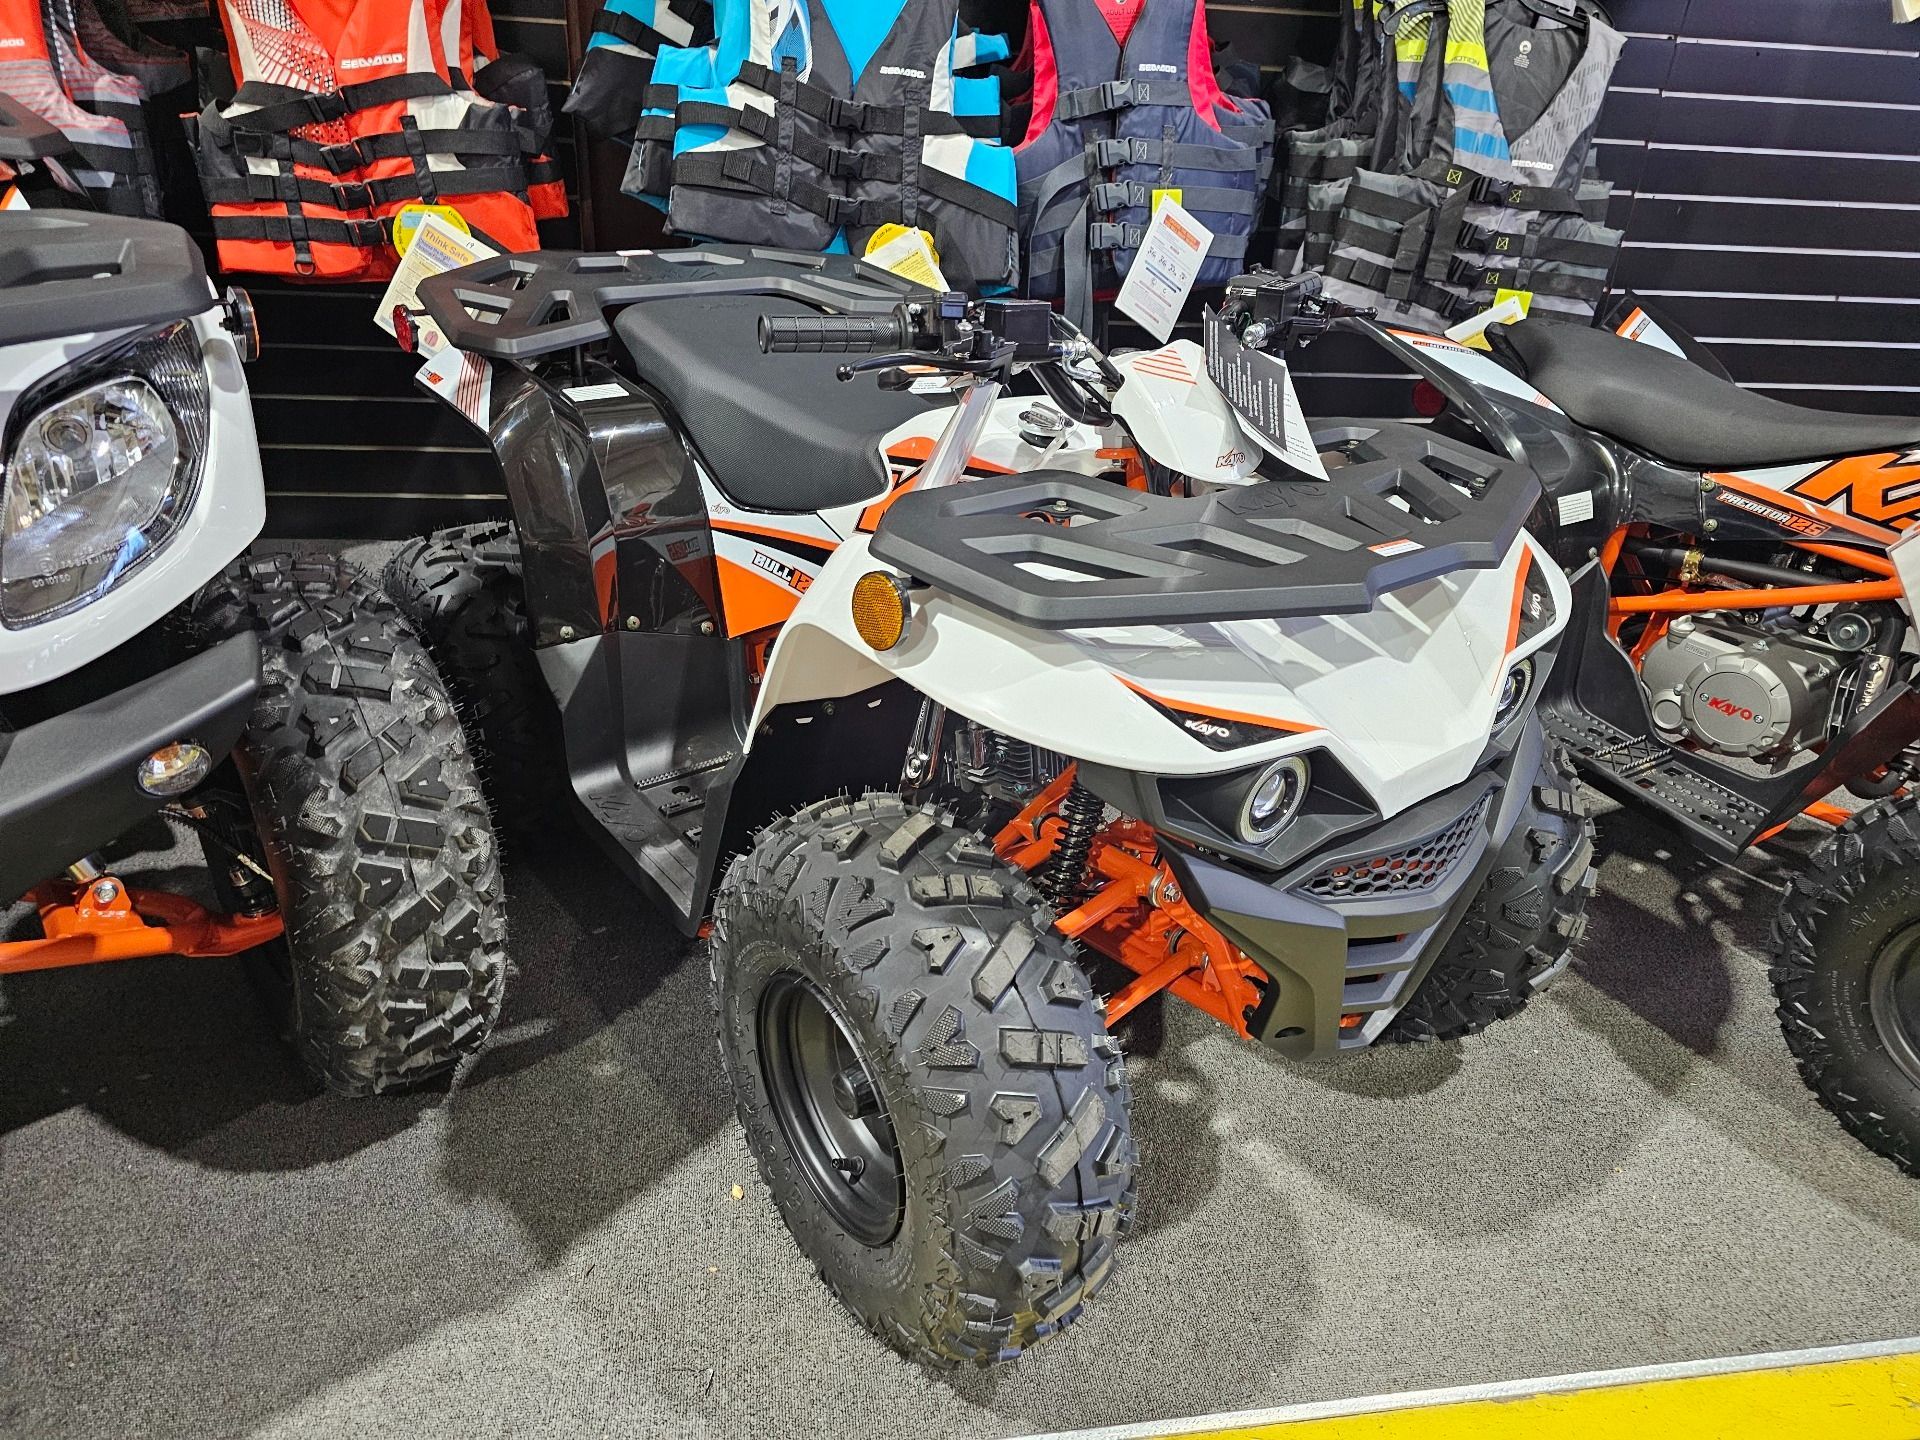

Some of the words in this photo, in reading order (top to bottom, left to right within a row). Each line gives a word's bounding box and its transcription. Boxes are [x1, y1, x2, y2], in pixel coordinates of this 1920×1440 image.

[423, 229, 450, 250] Think
[447, 245, 470, 263] Safe
[1216, 448, 1245, 468] KAYO
[1707, 697, 1753, 720] KAYO
[1184, 718, 1230, 738] KAYO
